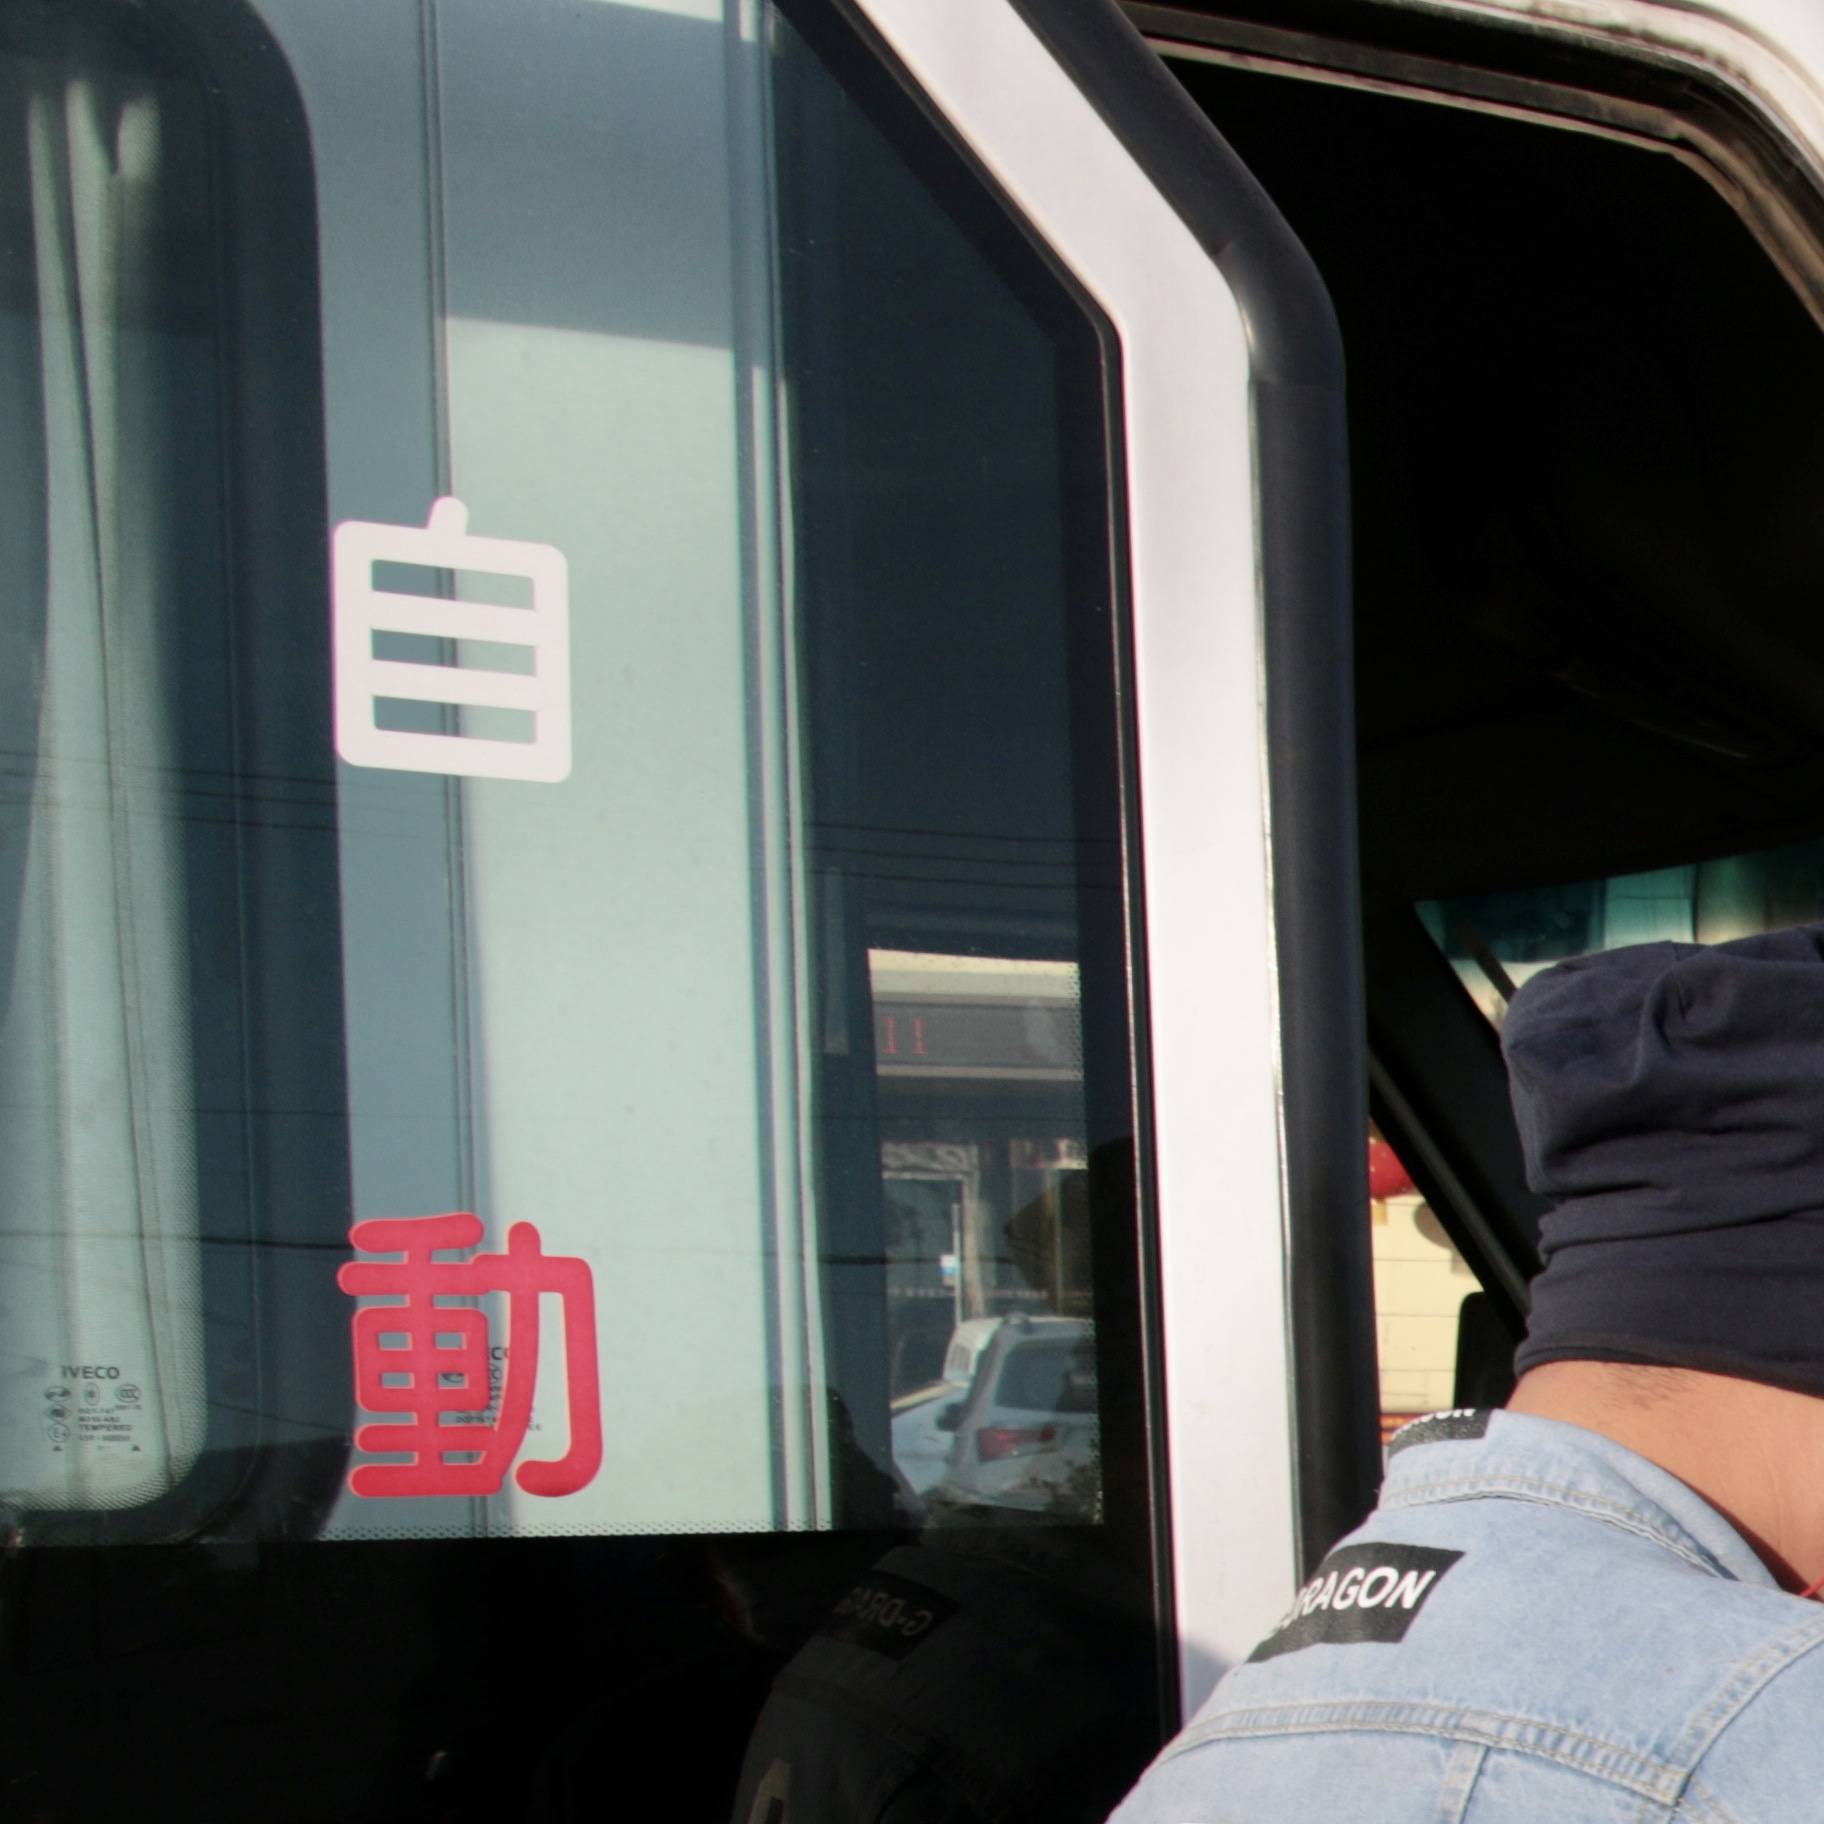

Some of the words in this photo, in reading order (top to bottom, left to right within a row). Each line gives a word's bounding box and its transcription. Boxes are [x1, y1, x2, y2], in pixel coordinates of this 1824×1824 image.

[333, 495, 573, 784] 自
[61, 1366, 121, 1380] IVECO
[337, 1211, 604, 1500] 動
